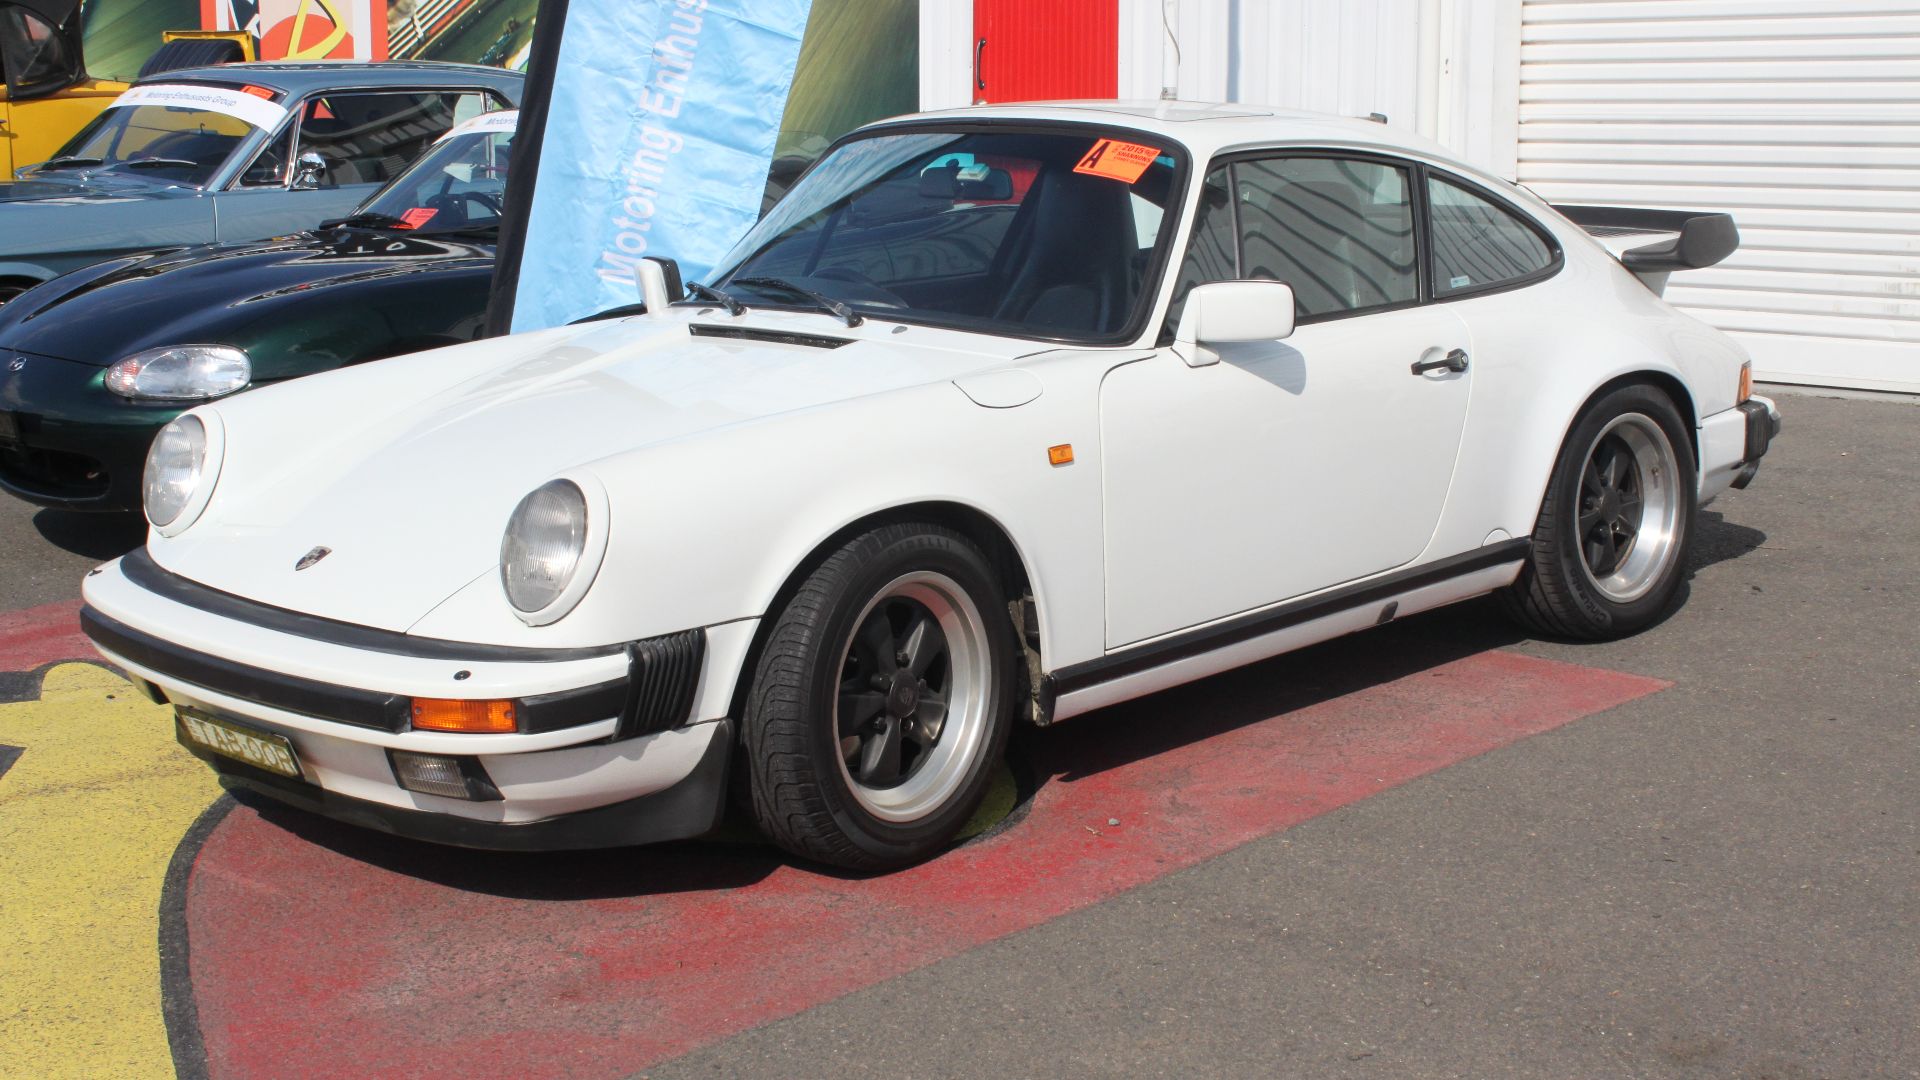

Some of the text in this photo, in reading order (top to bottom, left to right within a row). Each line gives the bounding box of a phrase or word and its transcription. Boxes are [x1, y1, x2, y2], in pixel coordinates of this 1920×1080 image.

[212, 95, 237, 108] Group
[1079, 140, 1111, 169] A
[1117, 151, 1151, 163] SHANNONS
[1121, 144, 1144, 154] 2015
[598, 125, 684, 287] Motoring
[887, 537, 950, 558] PIRELLI
